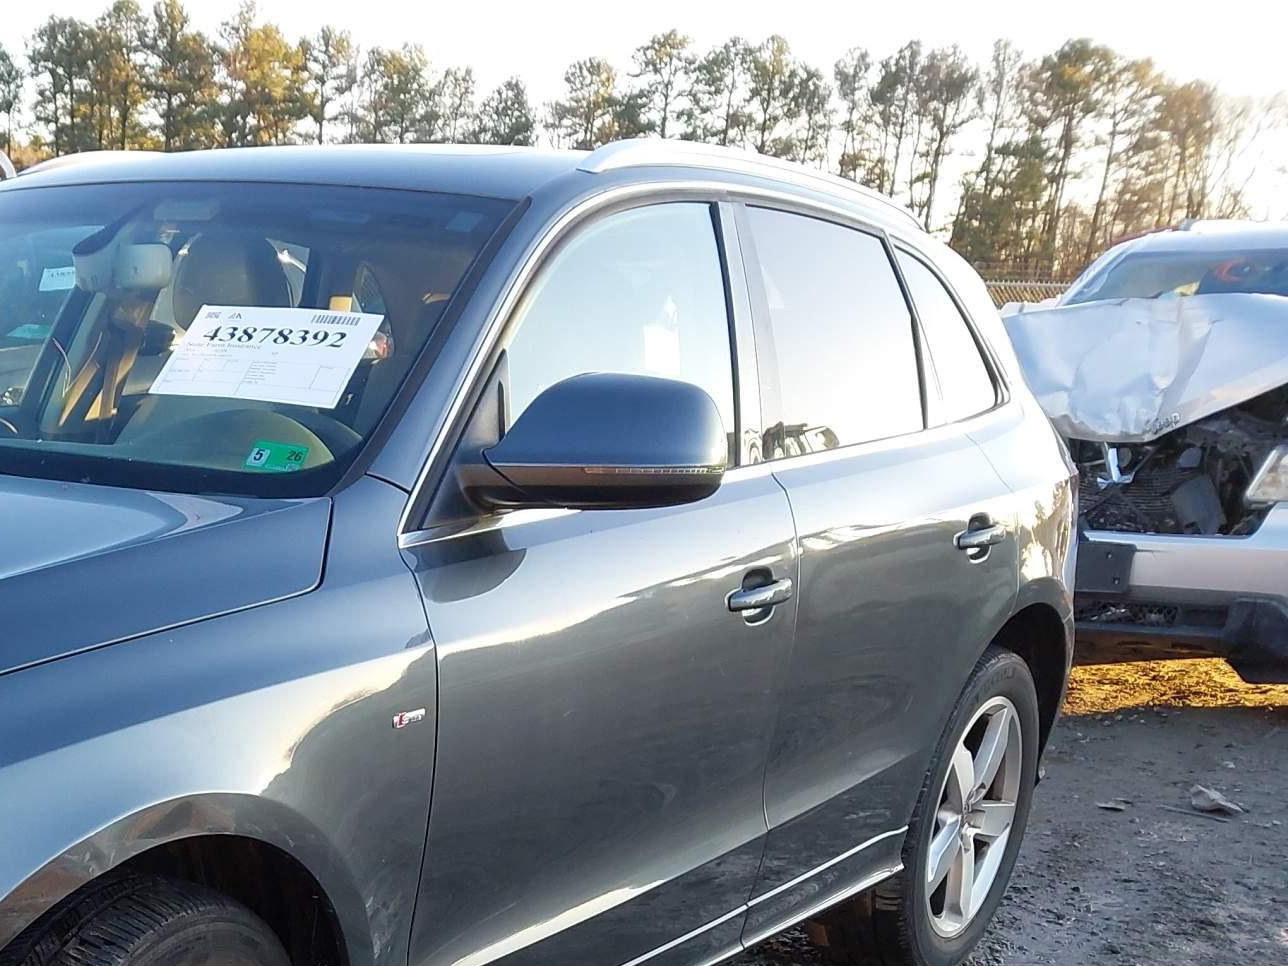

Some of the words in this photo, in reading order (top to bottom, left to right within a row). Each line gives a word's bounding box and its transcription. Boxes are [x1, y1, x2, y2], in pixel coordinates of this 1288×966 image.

[203, 326, 347, 347] 43878392
[253, 449, 265, 461] 5
[287, 450, 304, 462] 26
